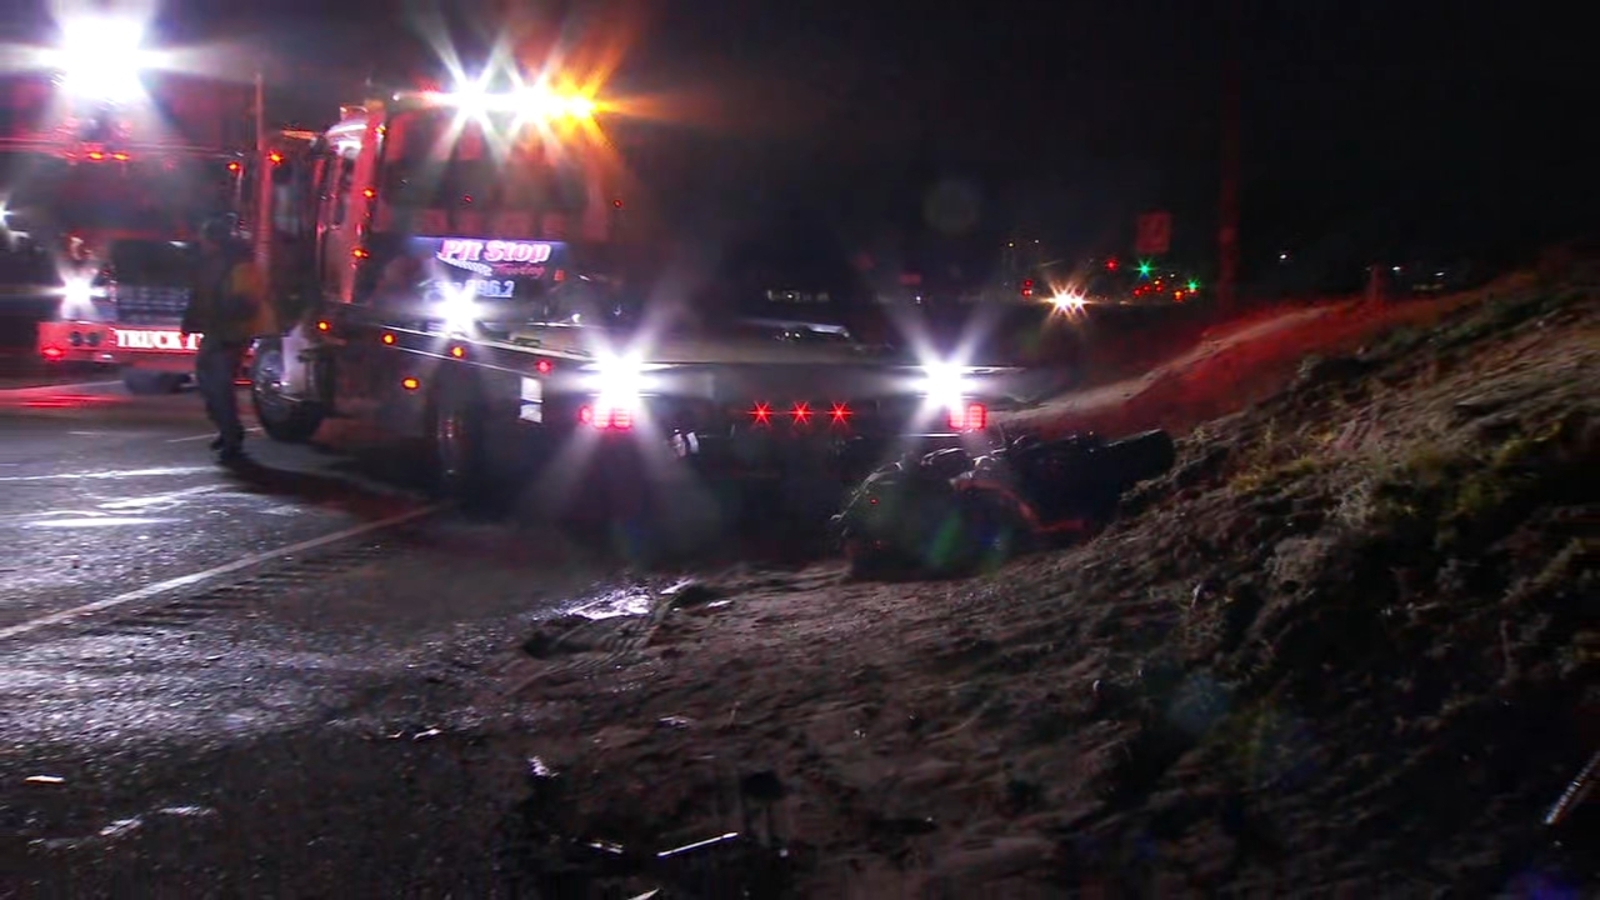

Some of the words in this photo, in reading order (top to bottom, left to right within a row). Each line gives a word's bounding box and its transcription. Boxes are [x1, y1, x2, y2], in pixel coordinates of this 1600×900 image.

[440, 240, 483, 261] Pit
[484, 240, 551, 263] Stop
[114, 329, 183, 350] TRUCK
